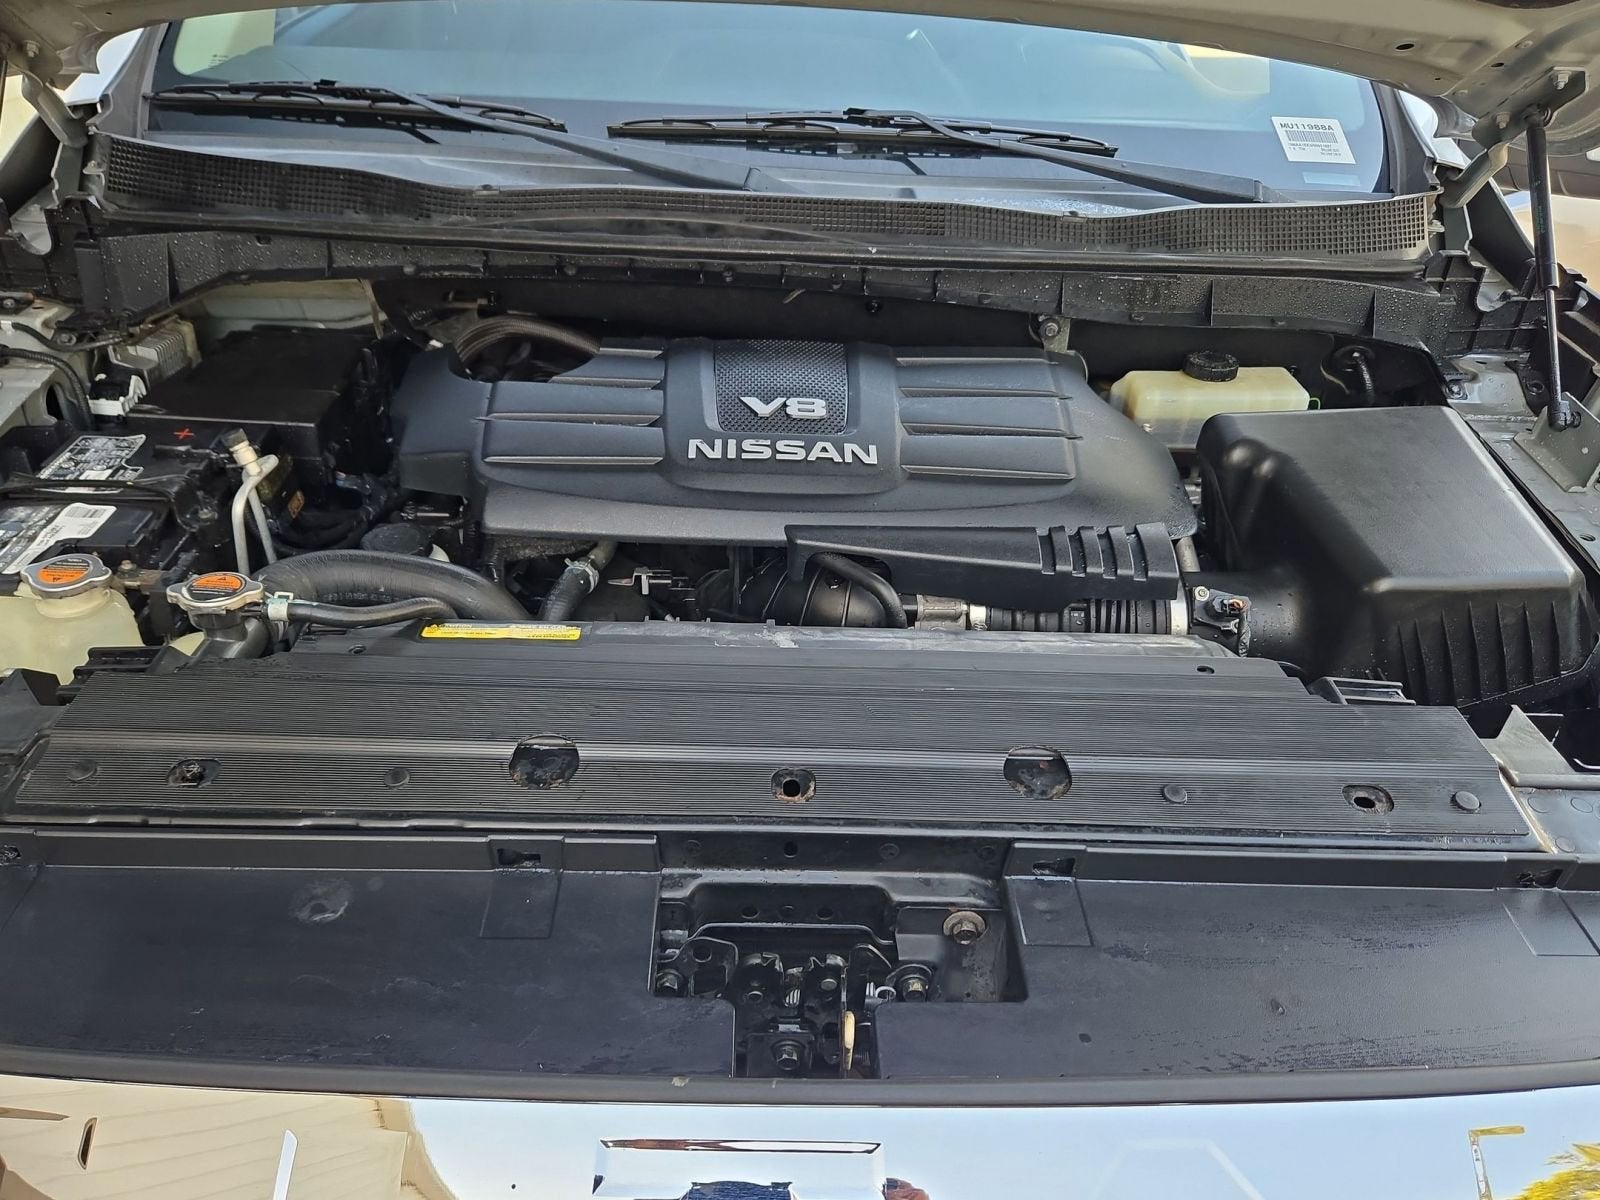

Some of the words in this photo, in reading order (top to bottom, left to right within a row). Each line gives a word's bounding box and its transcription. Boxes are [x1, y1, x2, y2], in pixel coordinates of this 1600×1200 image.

[1279, 122, 1334, 131] MU11988A
[739, 396, 827, 419] V8
[687, 438, 878, 464] NISSAN
